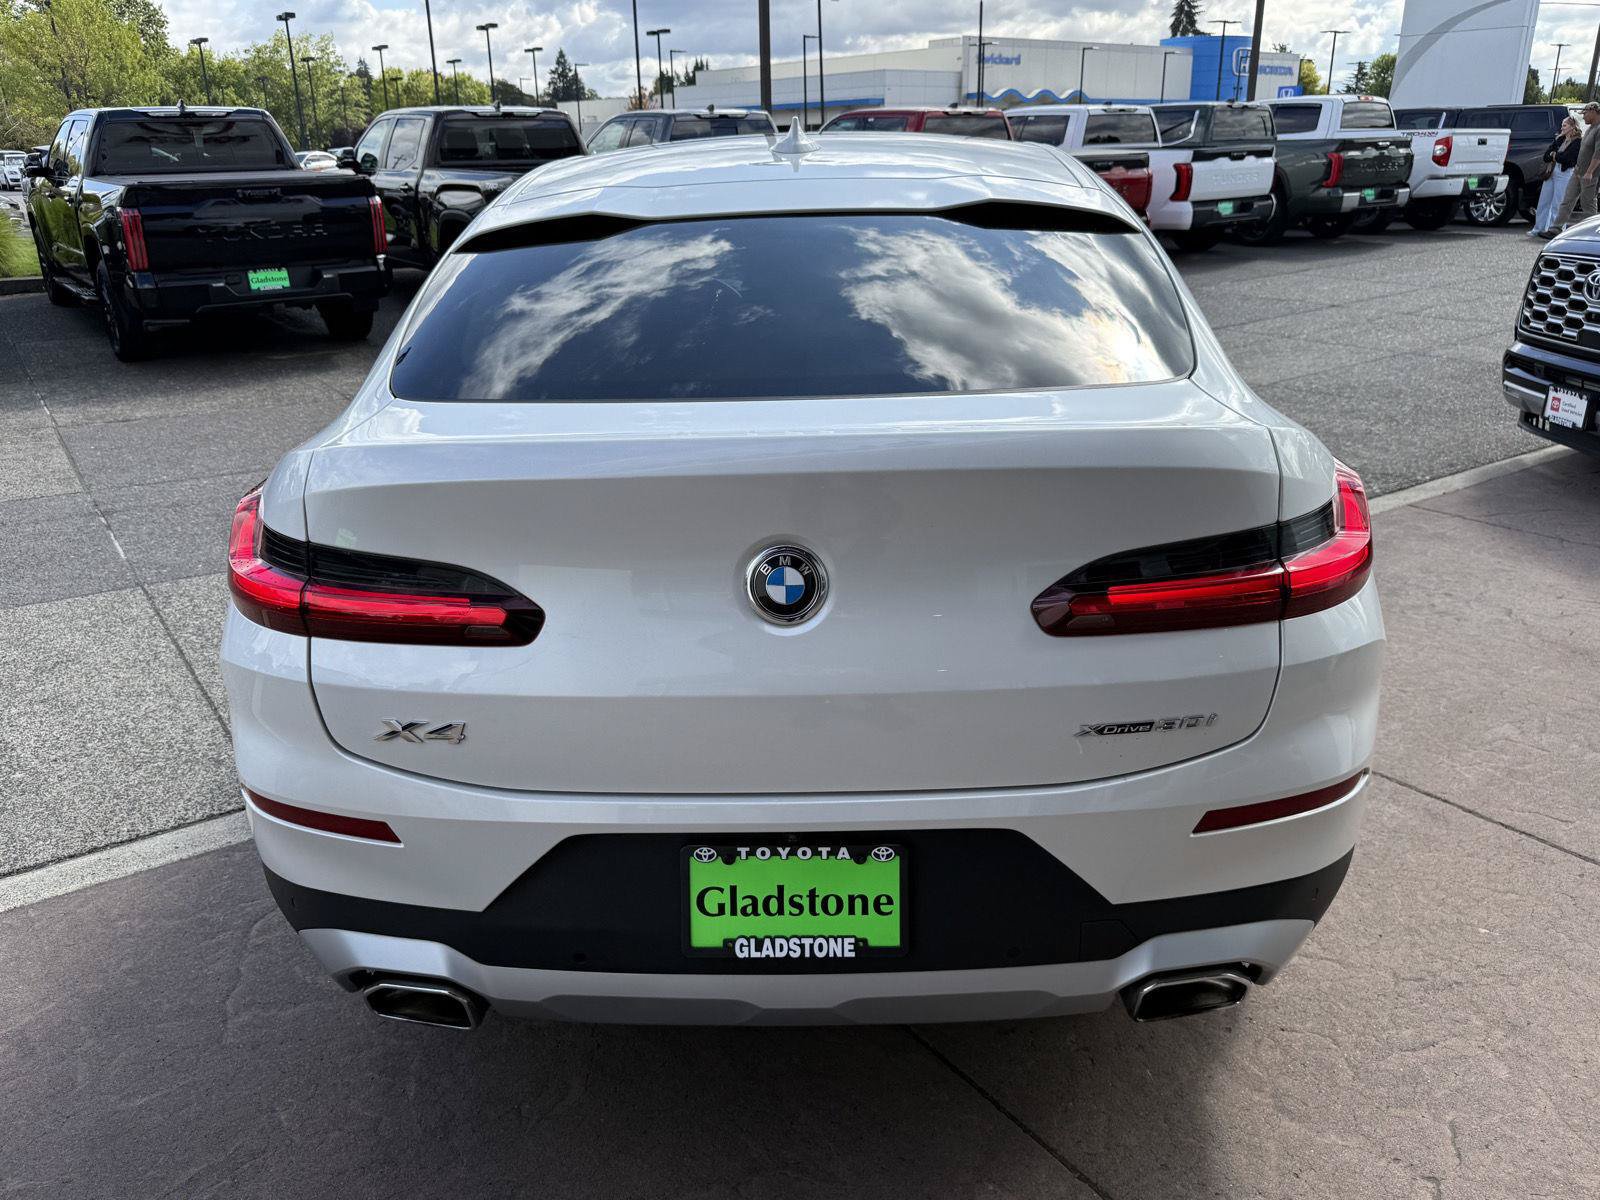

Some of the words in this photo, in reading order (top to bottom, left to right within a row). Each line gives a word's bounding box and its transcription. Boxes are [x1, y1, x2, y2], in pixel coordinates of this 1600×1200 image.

[250, 274, 289, 285] Gladstone
[759, 555, 812, 577] BMW
[373, 717, 466, 745] X4
[736, 846, 851, 860] TOYOTA
[695, 884, 895, 917] Gladstone
[734, 937, 856, 958] GLADSTONE
